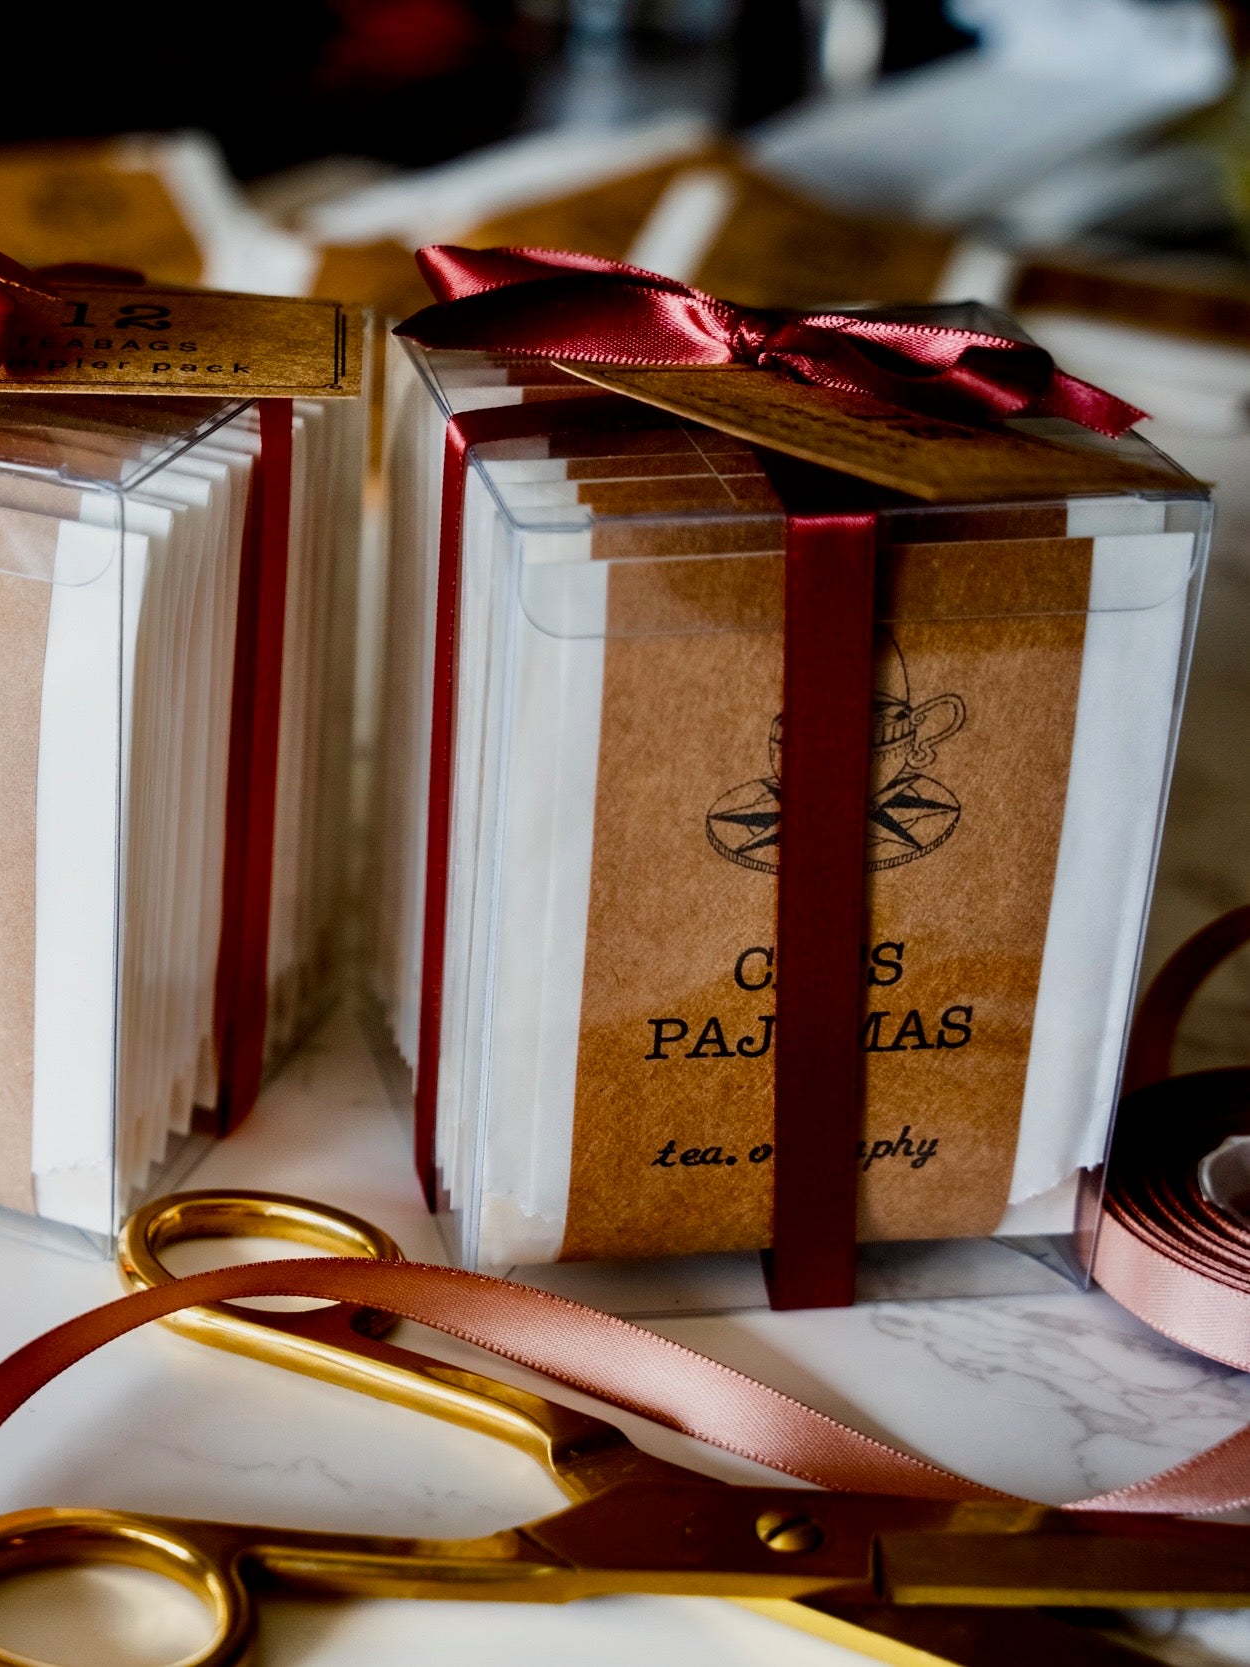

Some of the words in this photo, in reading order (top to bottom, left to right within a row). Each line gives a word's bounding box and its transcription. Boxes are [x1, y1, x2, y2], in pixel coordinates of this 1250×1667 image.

[60, 301, 172, 331] 12
[153, 361, 252, 374] pack
[734, 942, 905, 992] CS
[644, 1005, 974, 1061] PAJMAS
